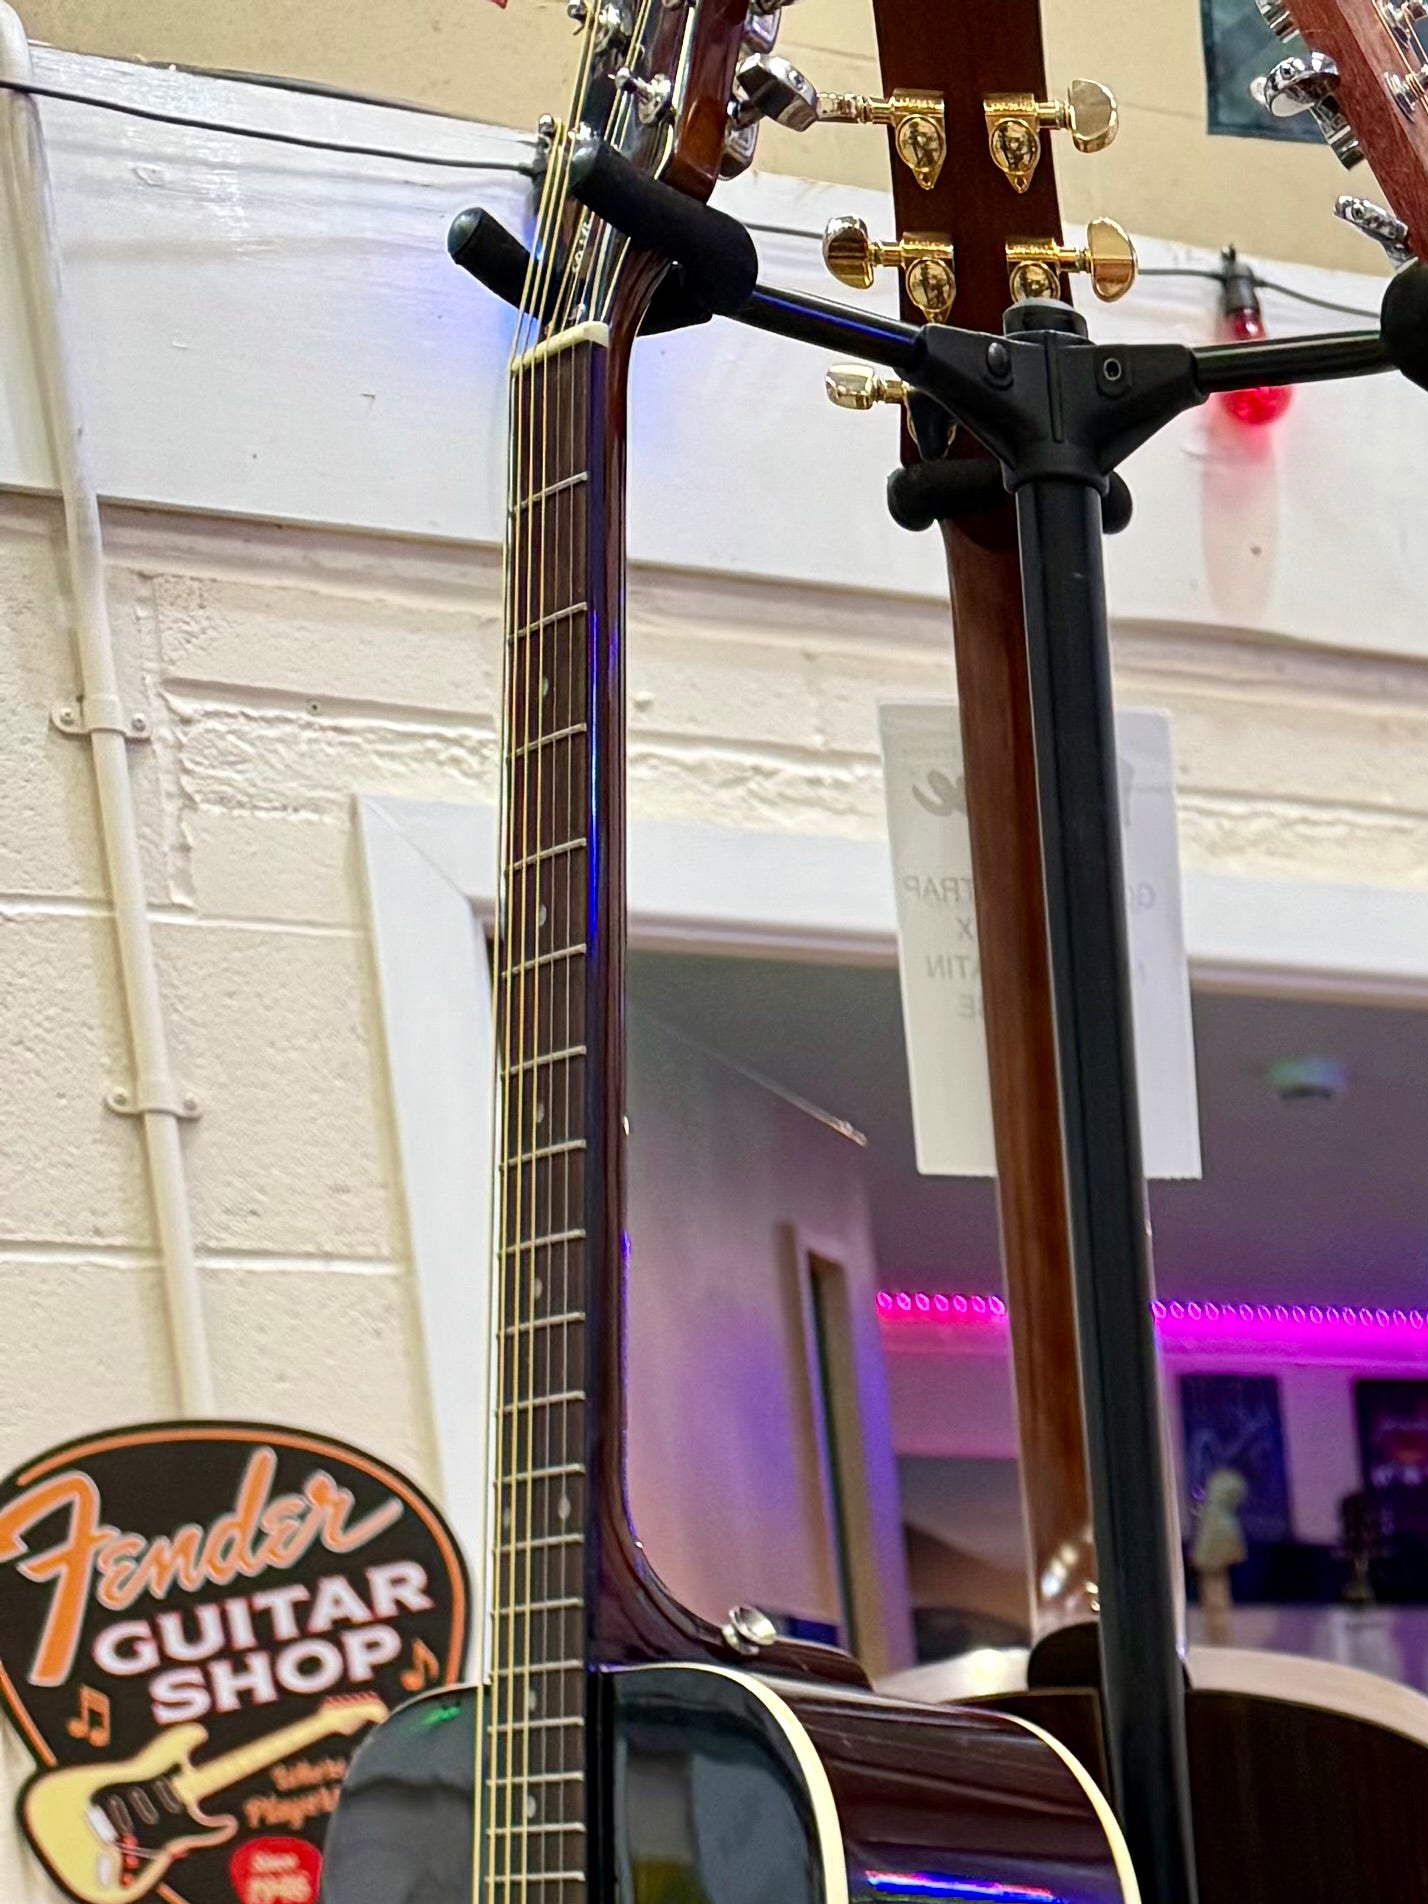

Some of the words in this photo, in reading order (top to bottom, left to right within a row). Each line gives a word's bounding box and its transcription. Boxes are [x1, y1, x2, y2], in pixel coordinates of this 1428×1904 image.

[0, 1445, 404, 1687] Fender
[91, 1560, 435, 1677] GUITAR
[149, 1625, 402, 1726] SHOP
